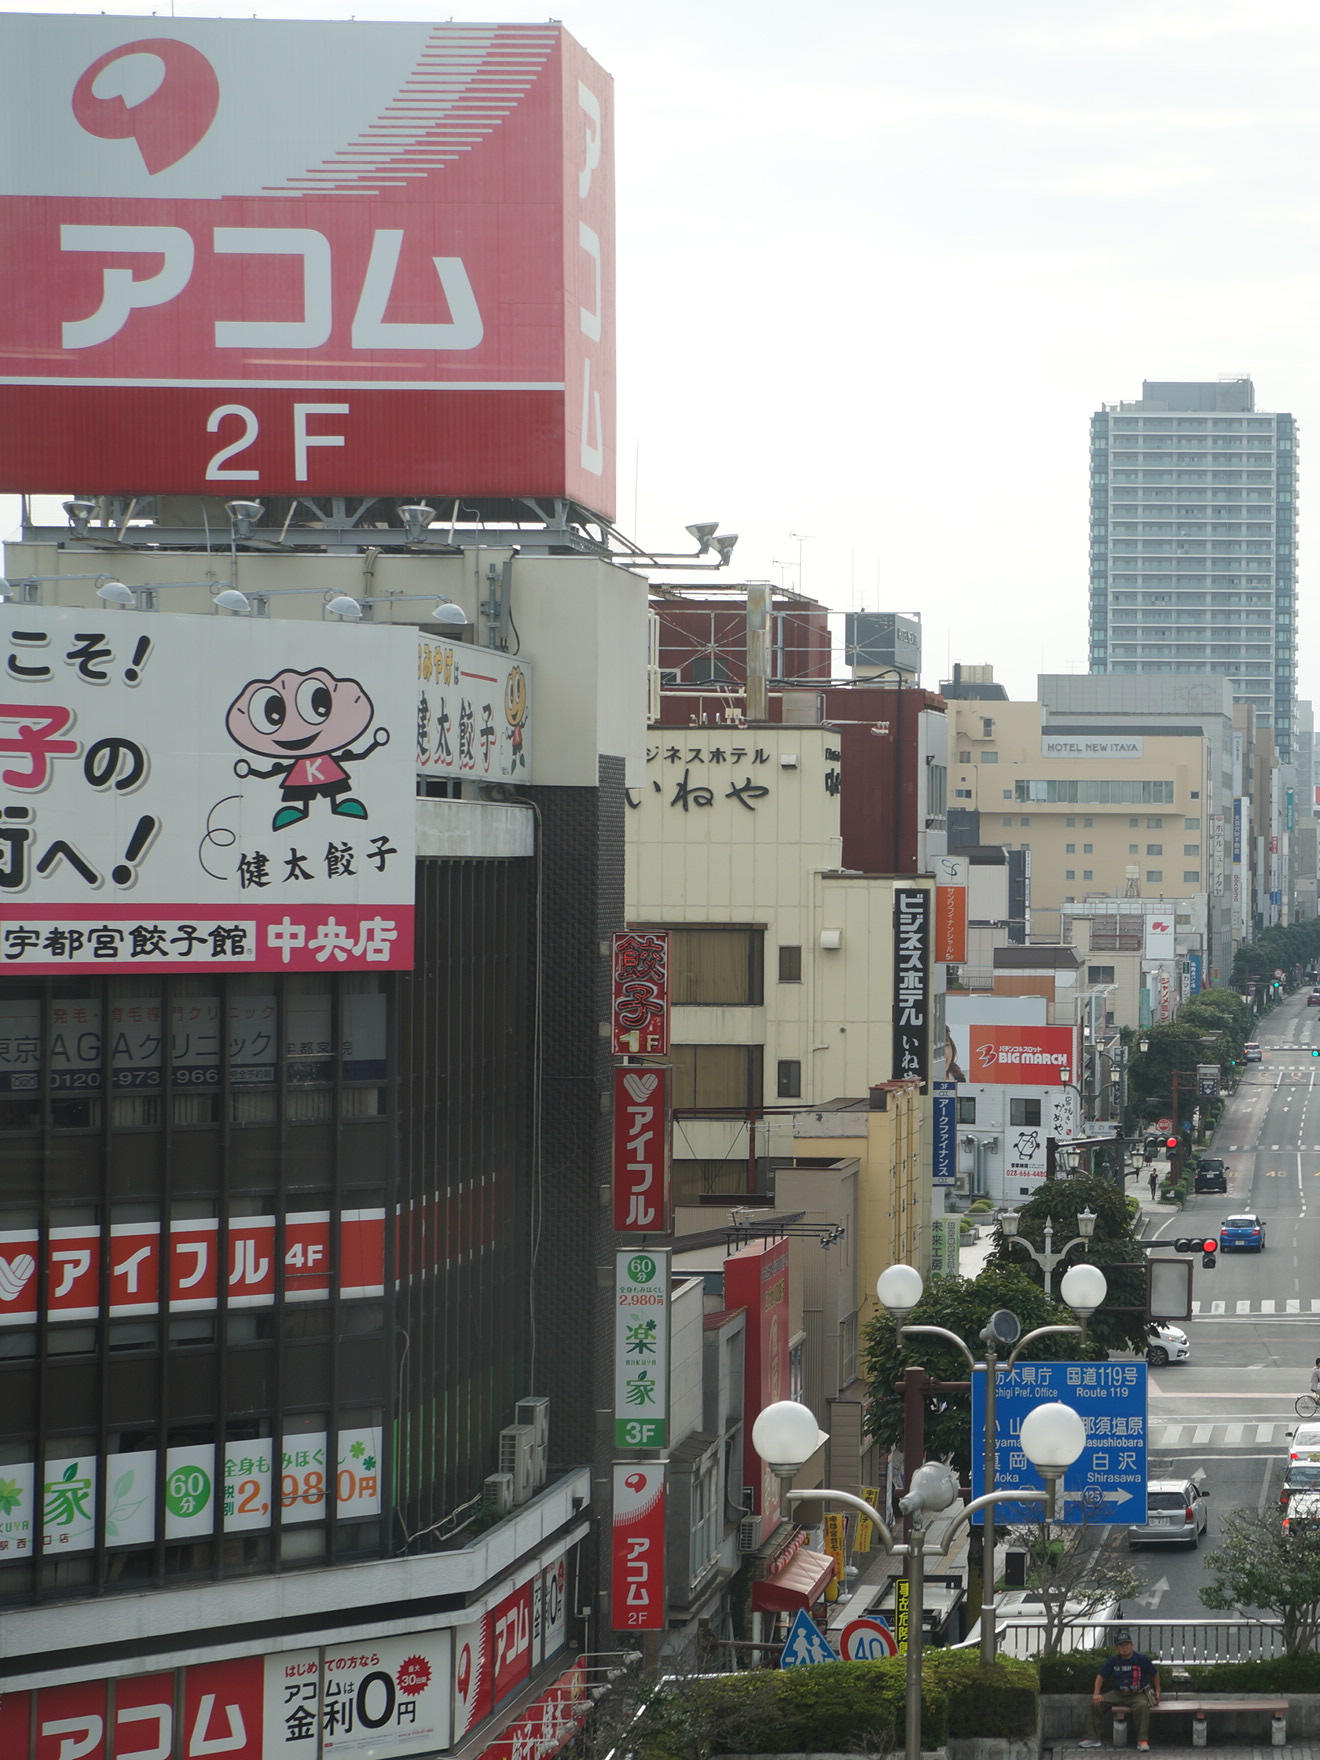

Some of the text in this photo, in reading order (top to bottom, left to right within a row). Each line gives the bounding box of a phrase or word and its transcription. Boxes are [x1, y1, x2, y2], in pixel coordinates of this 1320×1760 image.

[60, 224, 484, 350] アコム
[578, 79, 604, 477] アコム
[205, 403, 350, 481] 2F
[418, 643, 459, 686] みやげは
[1047, 743, 1138, 752] HOTEL NEW ITAYA
[625, 767, 769, 812] いねや
[237, 835, 398, 889] 健太餃子
[4, 916, 398, 963] 宇都宮餃子館 中央店
[899, 893, 924, 1026] ビジネスホテル
[616, 935, 666, 1028] 餃子
[1161, 977, 1170, 1022] ジャノメミシ
[619, 1030, 660, 1053] 1F
[999, 1052, 1067, 1064] BIG MARCH
[50, 1069, 218, 1088] 0120-973-966
[939, 1098, 949, 1176] アークファイナンス
[626, 1106, 655, 1226] アイフル
[52, 1240, 323, 1298] アイフル 4F
[631, 1259, 652, 1273] 60
[636, 1273, 647, 1282] 分
[619, 1294, 664, 1307] 2,980円
[1066, 1367, 1138, 1386] 国道119号
[995, 1388, 1058, 1399] chigi Pref. Office
[1076, 1388, 1129, 1398] Route 119
[625, 1422, 655, 1444] 3F
[1082, 1417, 1144, 1435] 那須塩原
[995, 1439, 1021, 1449] yama
[1085, 1438, 1144, 1448] asushiobara
[1092, 1452, 1137, 1470] 白沢
[170, 1473, 204, 1497] 60
[1087, 1472, 1141, 1482] Shirasawa
[179, 1496, 196, 1513] 分
[1085, 1492, 1101, 1501] 125
[627, 1538, 650, 1605] アコム
[627, 1612, 648, 1625] 2F
[495, 1598, 530, 1678] アコム
[854, 1637, 884, 1661] 40
[285, 1653, 380, 1678] はじめての方なら
[284, 1679, 354, 1704] アコムは
[401, 1674, 428, 1687] 30日間
[41, 1694, 248, 1760] アコム
